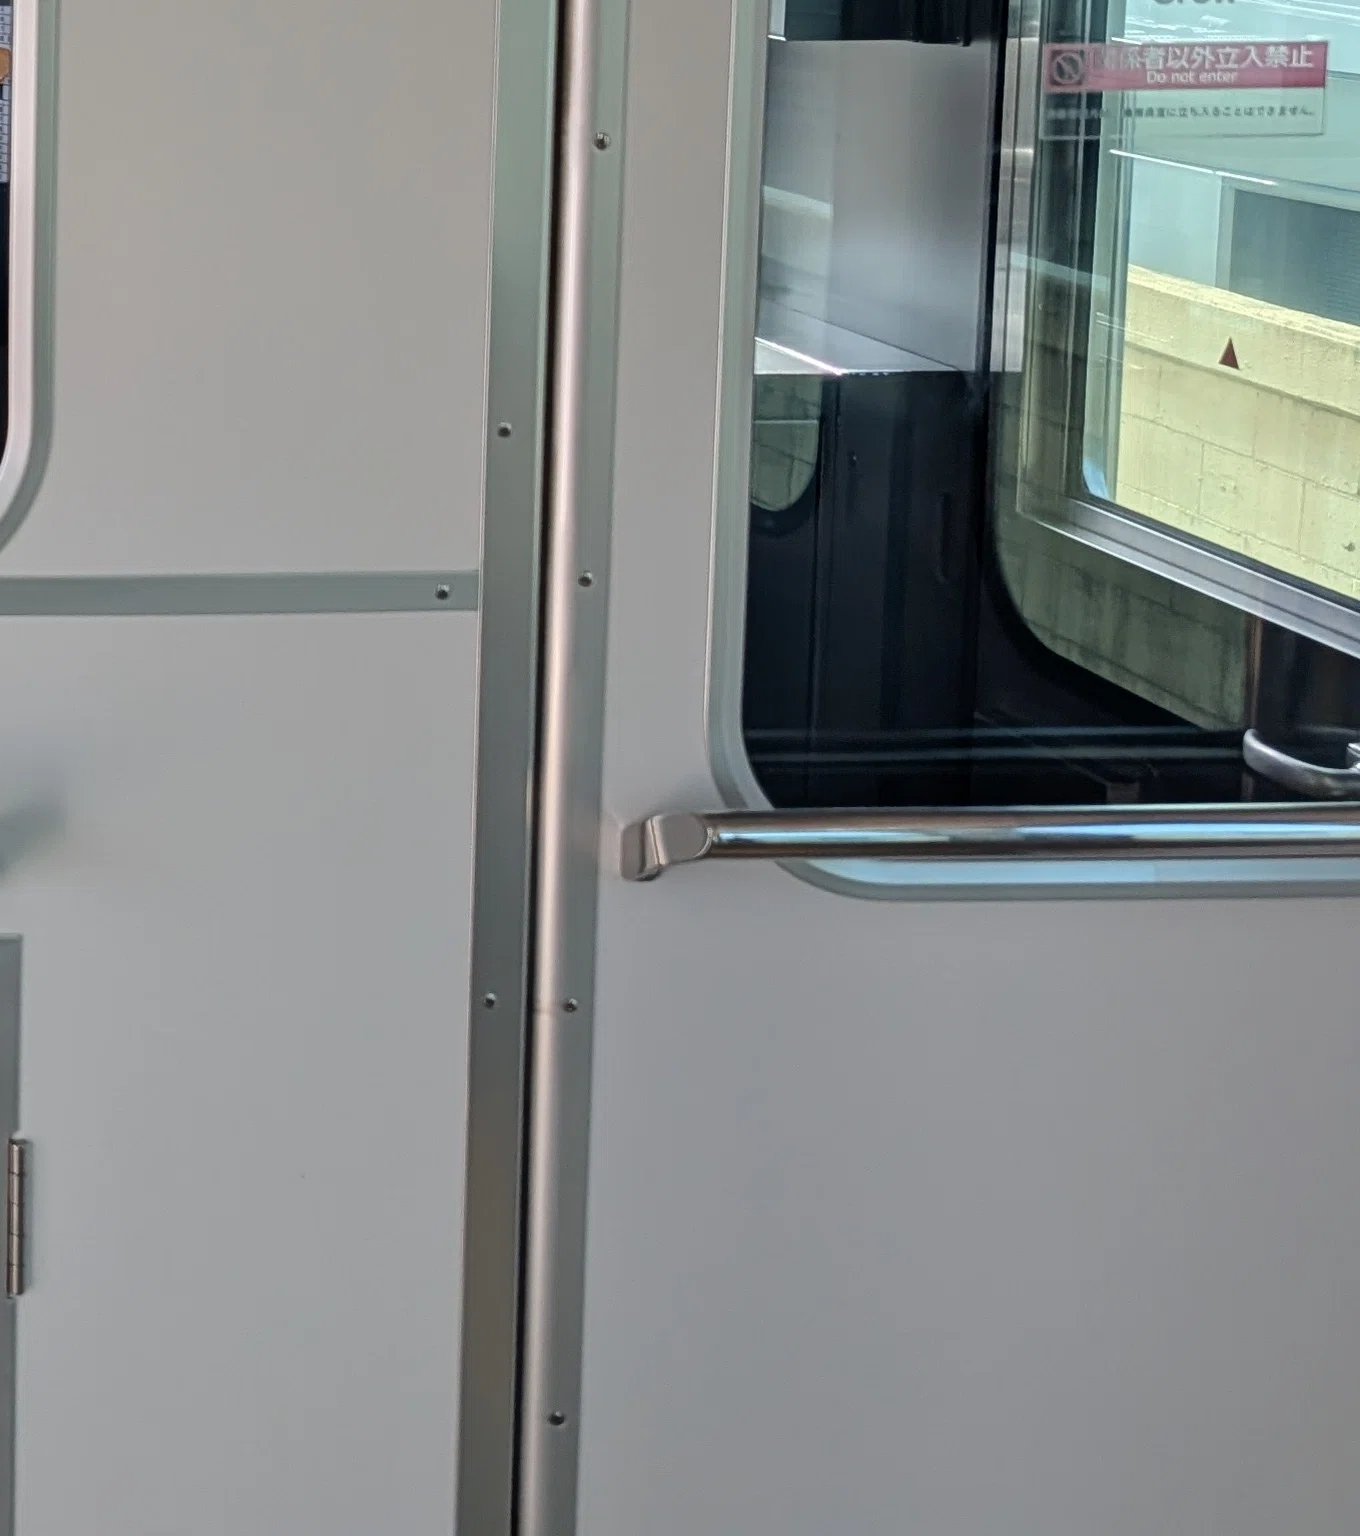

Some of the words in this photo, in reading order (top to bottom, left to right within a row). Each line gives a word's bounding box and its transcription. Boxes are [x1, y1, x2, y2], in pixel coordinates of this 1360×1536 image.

[1146, 71, 1165, 84] Do
[1171, 71, 1196, 84] not
[1199, 71, 1238, 84] enter
